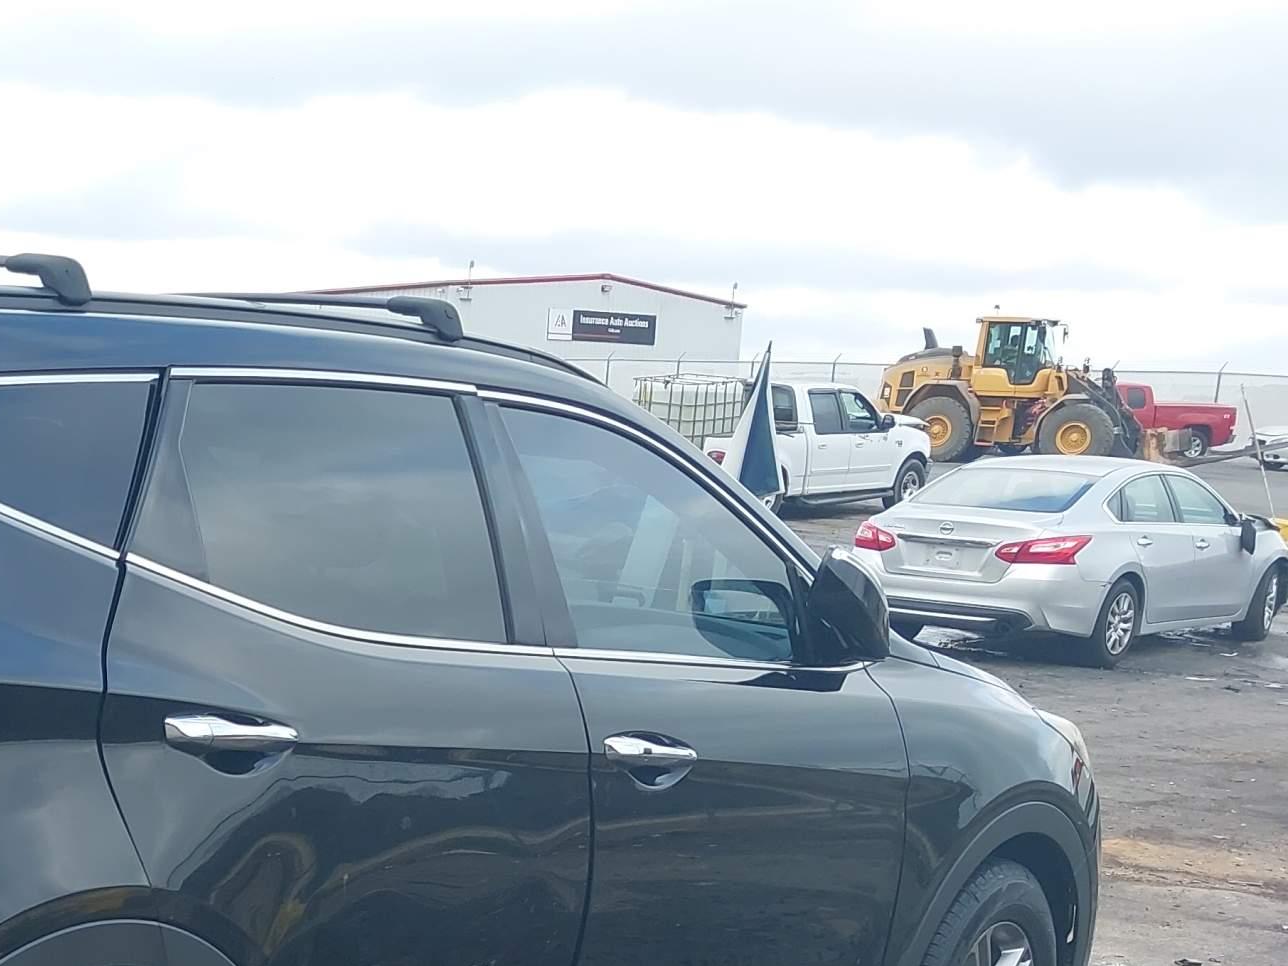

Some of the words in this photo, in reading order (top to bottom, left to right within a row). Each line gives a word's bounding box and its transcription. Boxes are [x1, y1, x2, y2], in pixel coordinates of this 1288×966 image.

[579, 314, 609, 326] Insurance
[609, 316, 624, 327] Auto
[623, 317, 649, 329] Auctions
